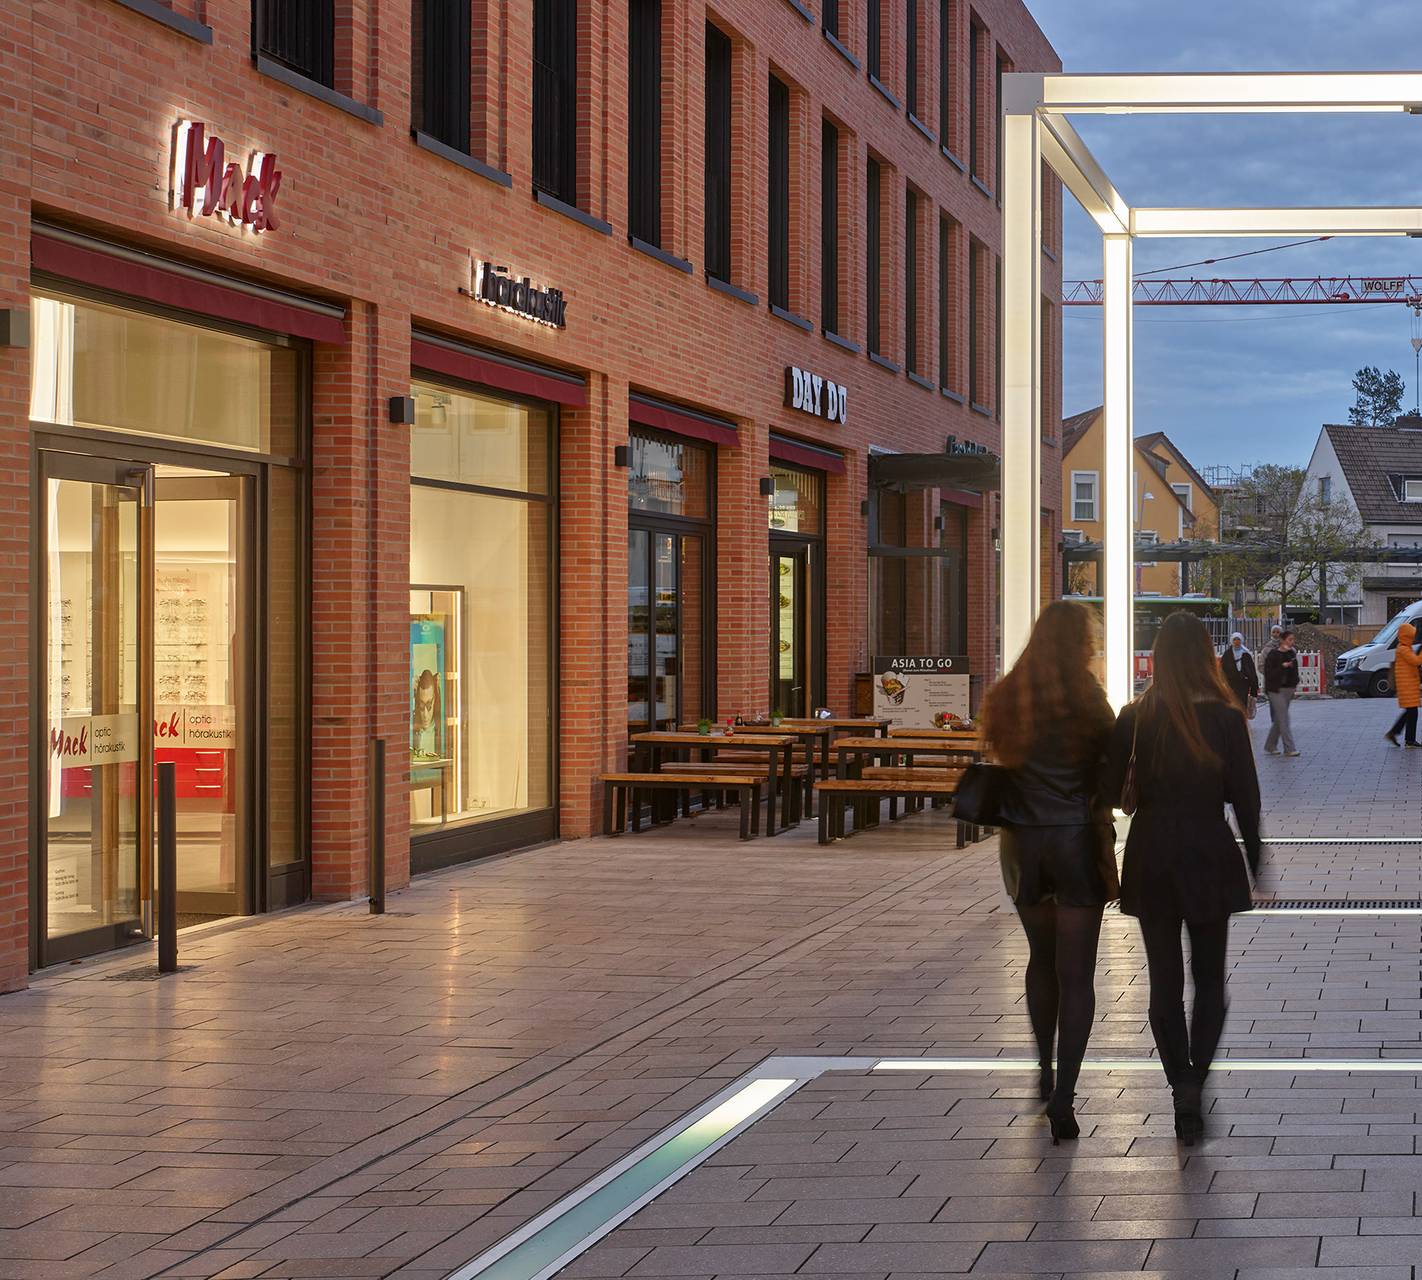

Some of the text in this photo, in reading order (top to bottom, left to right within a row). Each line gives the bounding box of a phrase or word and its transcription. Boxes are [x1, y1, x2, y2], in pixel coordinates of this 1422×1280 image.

[177, 120, 282, 231] Mack
[1363, 281, 1404, 291] WOLFF
[791, 366, 847, 425] DAY DU
[891, 658, 952, 668] ASIA TO GO
[153, 712, 180, 738] ck
[189, 714, 212, 725] optic
[94, 726, 112, 739] optic
[188, 729, 232, 739] hörakustik
[51, 724, 88, 759] Mack
[94, 741, 126, 754] hörakustik
